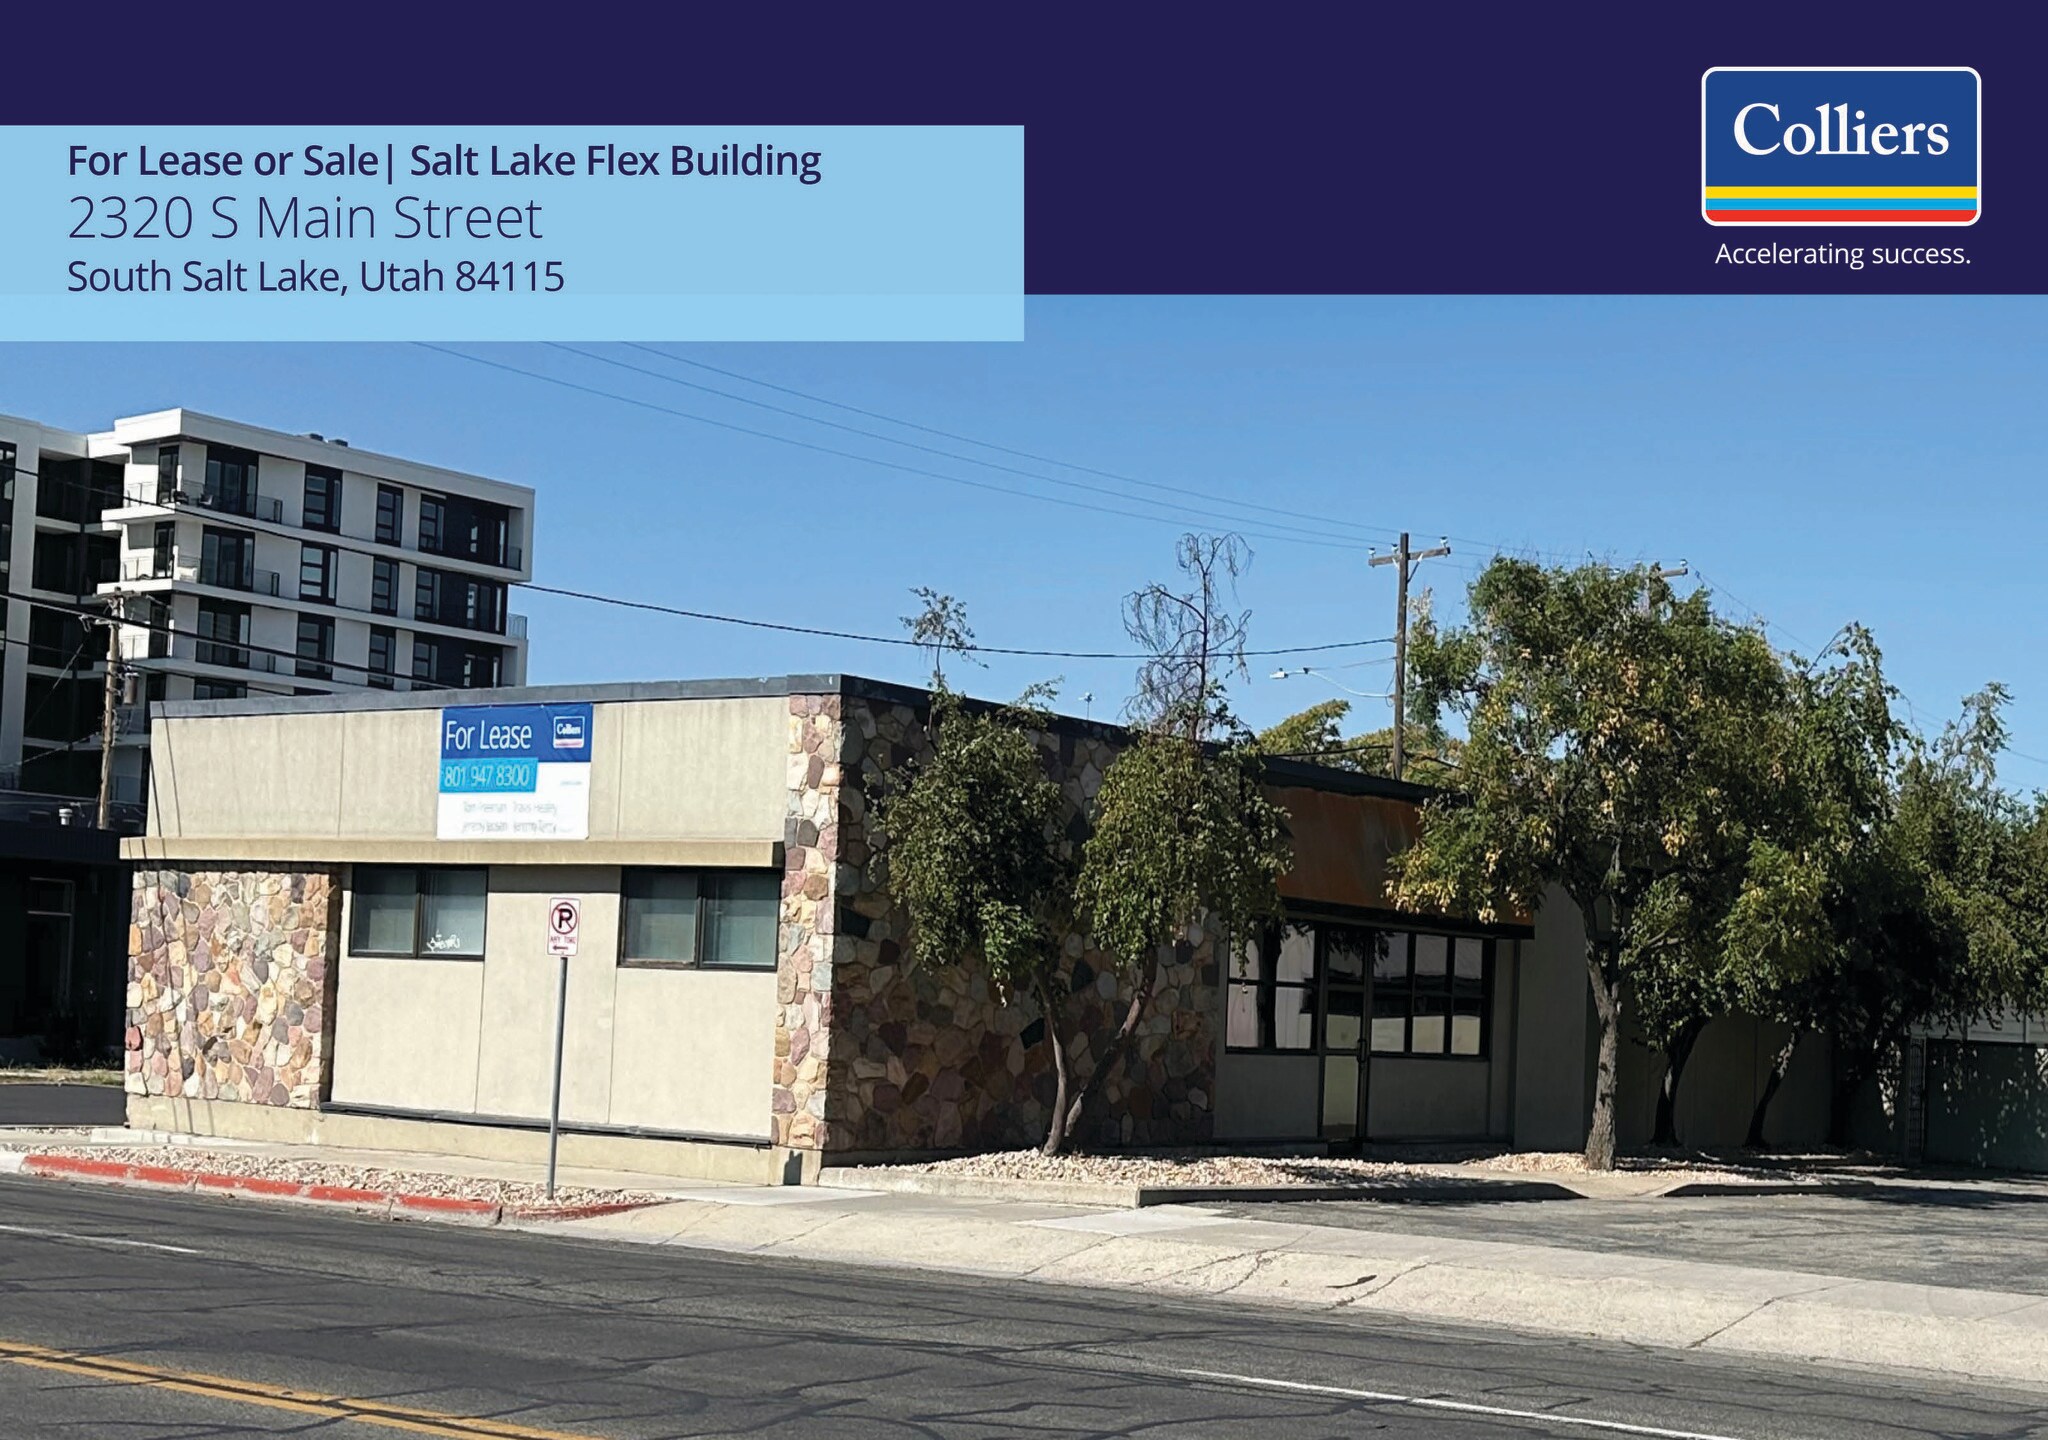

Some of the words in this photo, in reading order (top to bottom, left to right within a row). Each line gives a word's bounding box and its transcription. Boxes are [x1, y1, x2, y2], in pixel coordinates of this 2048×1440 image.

[445, 720, 476, 750] For
[479, 719, 532, 750] Lease
[444, 766, 466, 787] 801
[470, 765, 494, 787] 947
[495, 764, 530, 787] 8300
